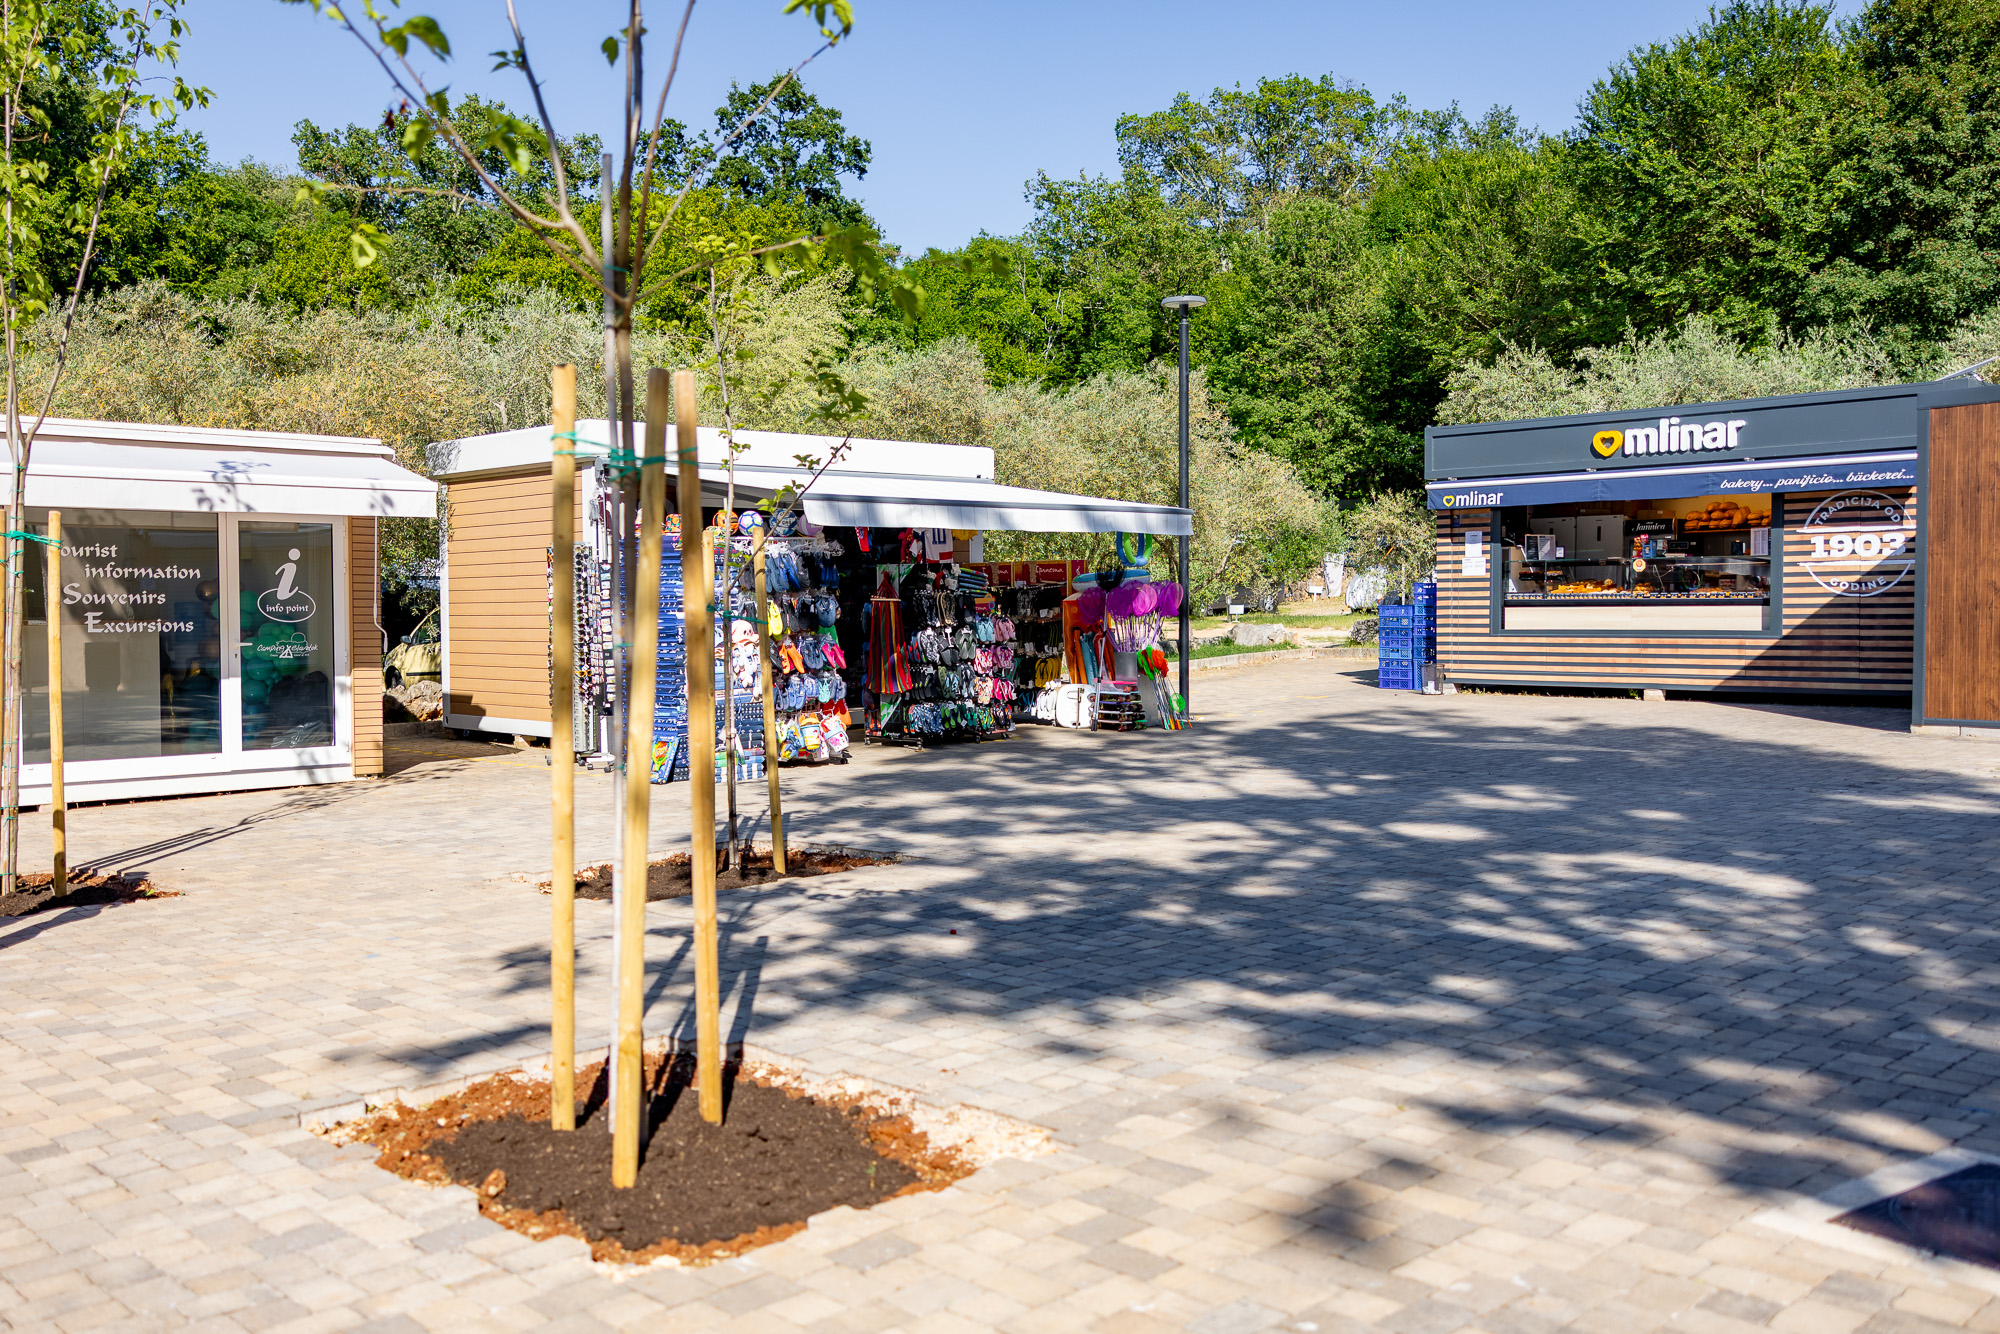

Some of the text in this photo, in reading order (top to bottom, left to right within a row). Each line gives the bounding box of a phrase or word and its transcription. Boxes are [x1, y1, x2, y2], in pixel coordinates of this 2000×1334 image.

[1624, 417, 1747, 455] mlinar
[1720, 479, 1773, 491] bakery...
[1774, 473, 1844, 488] panificio...
[1455, 491, 1504, 507] mlinar
[1814, 497, 1901, 526] TRADICIJA OD
[57, 543, 118, 558] ourist
[1810, 532, 1906, 558] 1903
[84, 561, 201, 579] information
[1829, 576, 1887, 591] GODINE
[63, 582, 166, 605] Souvenirs
[266, 603, 309, 614] info point
[84, 611, 194, 633] Excursions
